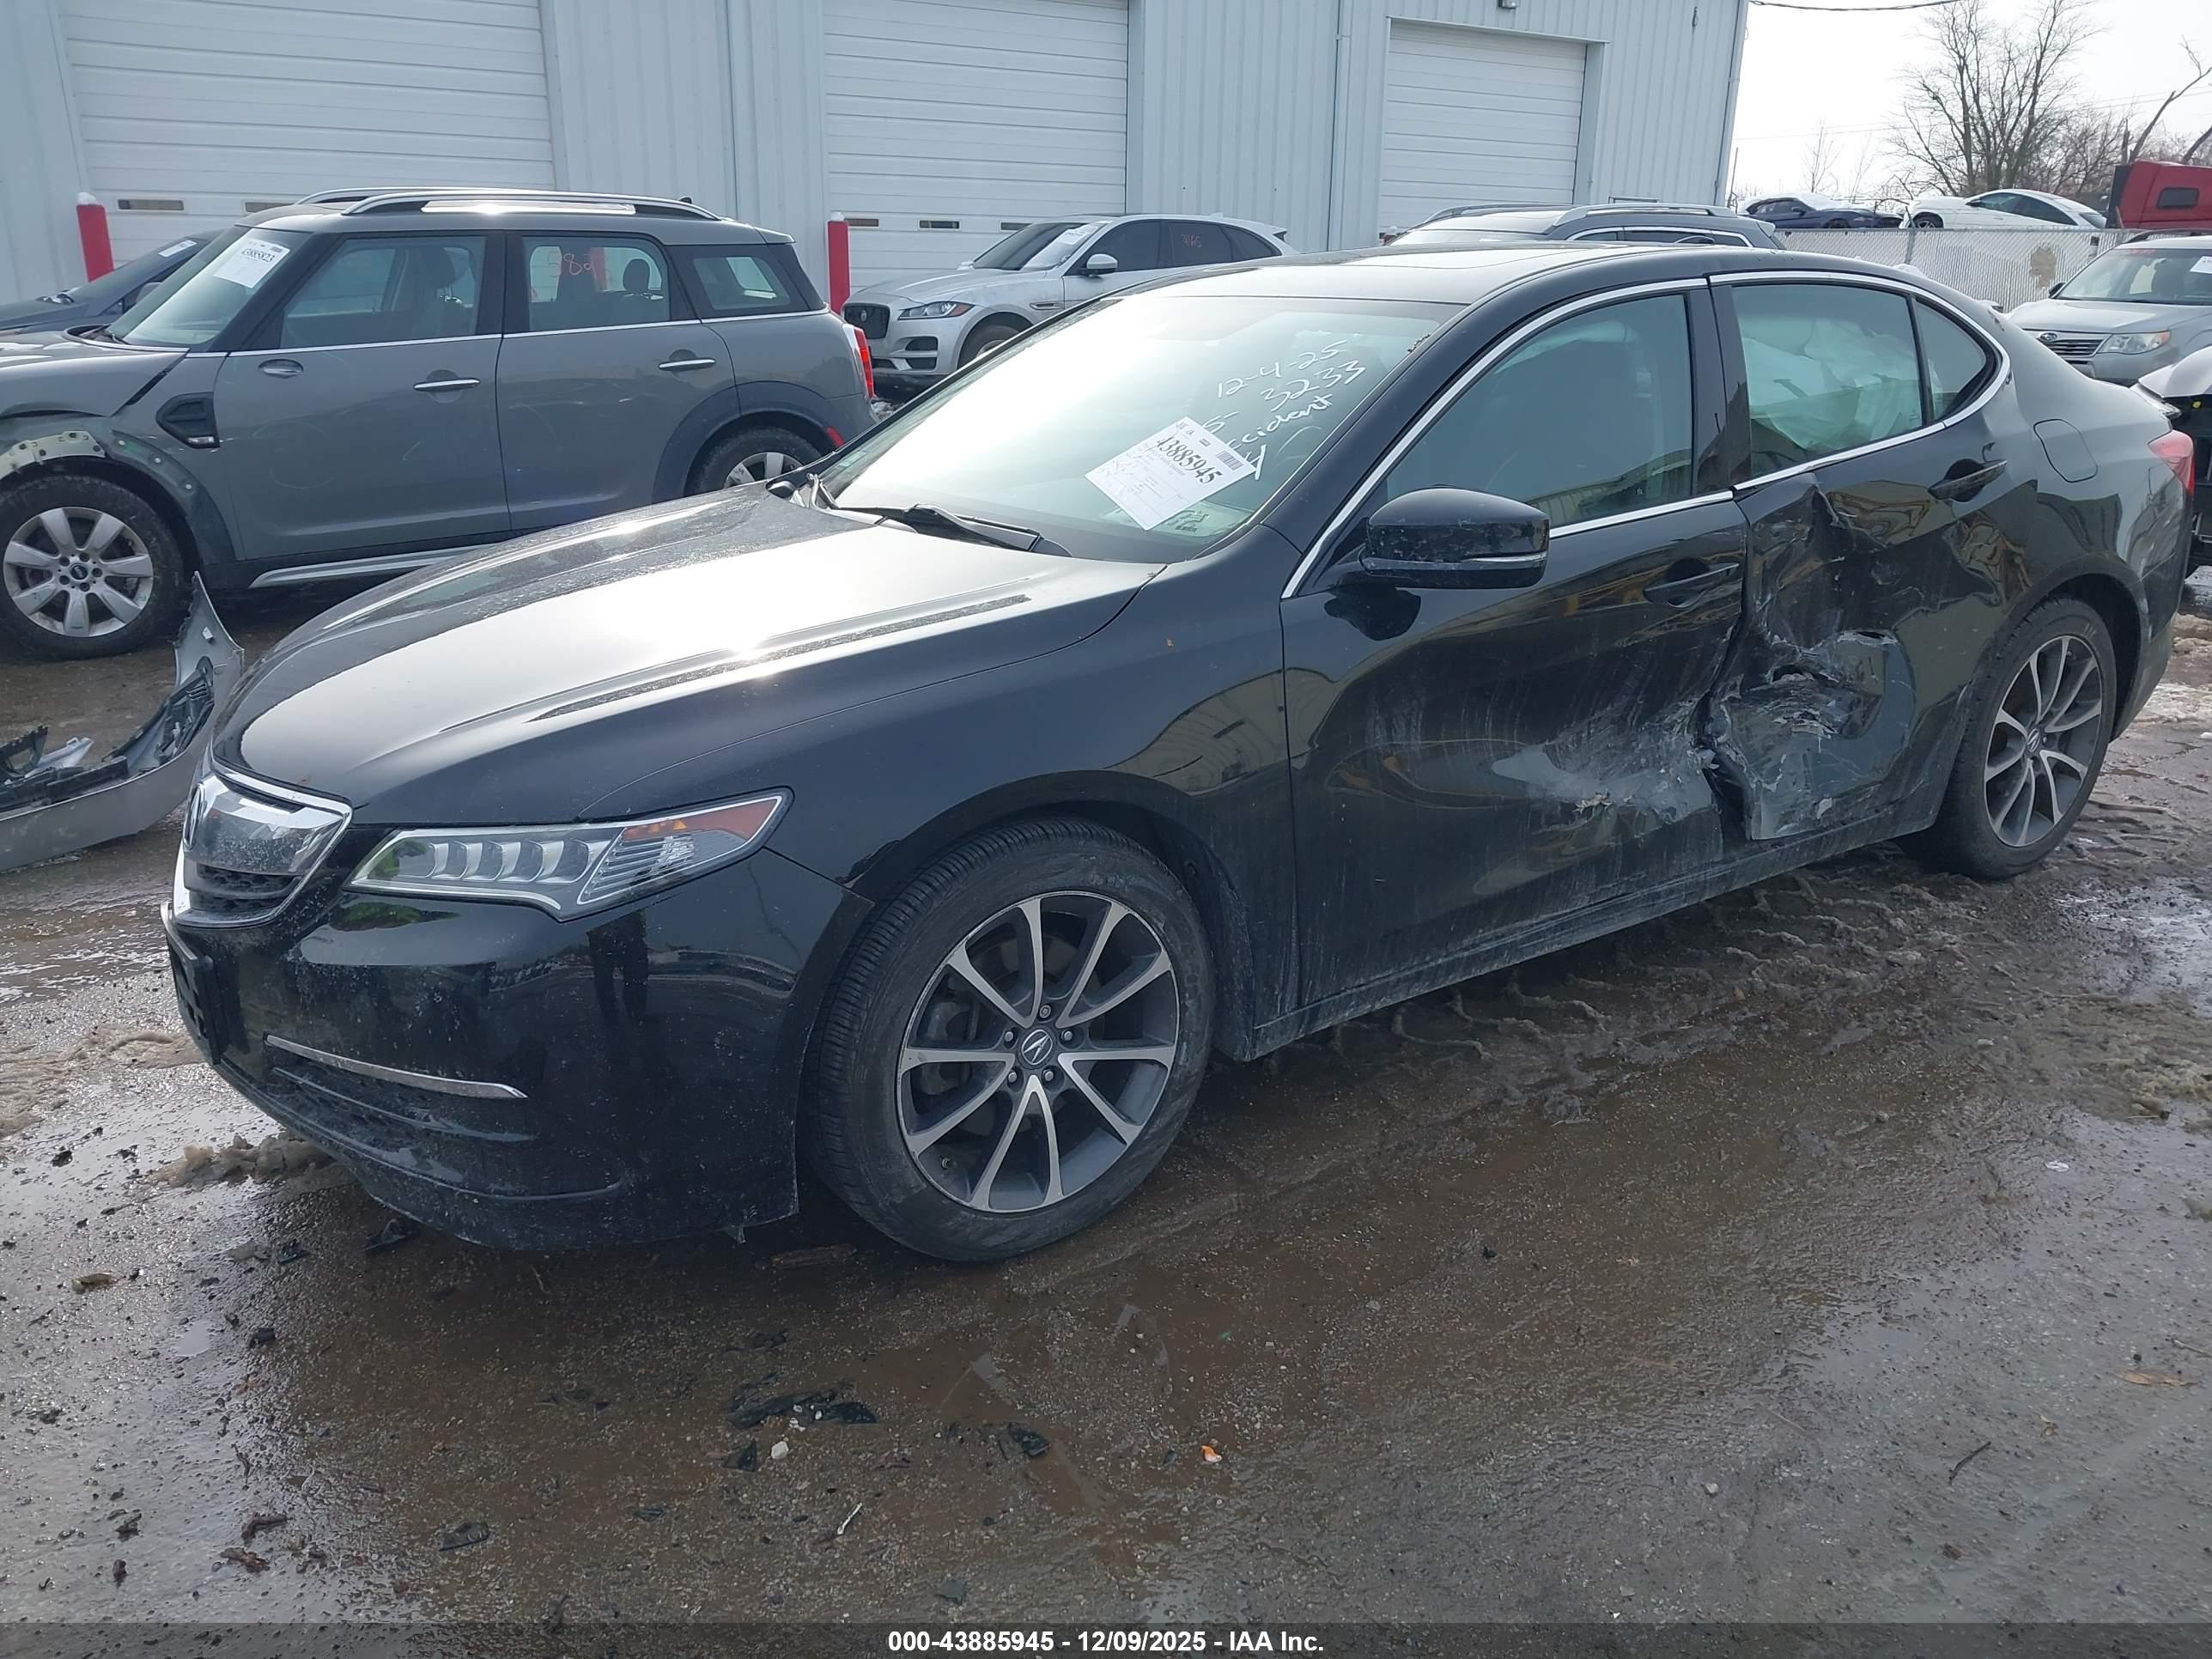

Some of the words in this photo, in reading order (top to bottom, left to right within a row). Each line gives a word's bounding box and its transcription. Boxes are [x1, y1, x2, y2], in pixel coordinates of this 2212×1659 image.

[1218, 339, 1347, 398] 12-4-25
[1260, 360, 1367, 412] 3233
[1156, 436, 1224, 484] 43885945
